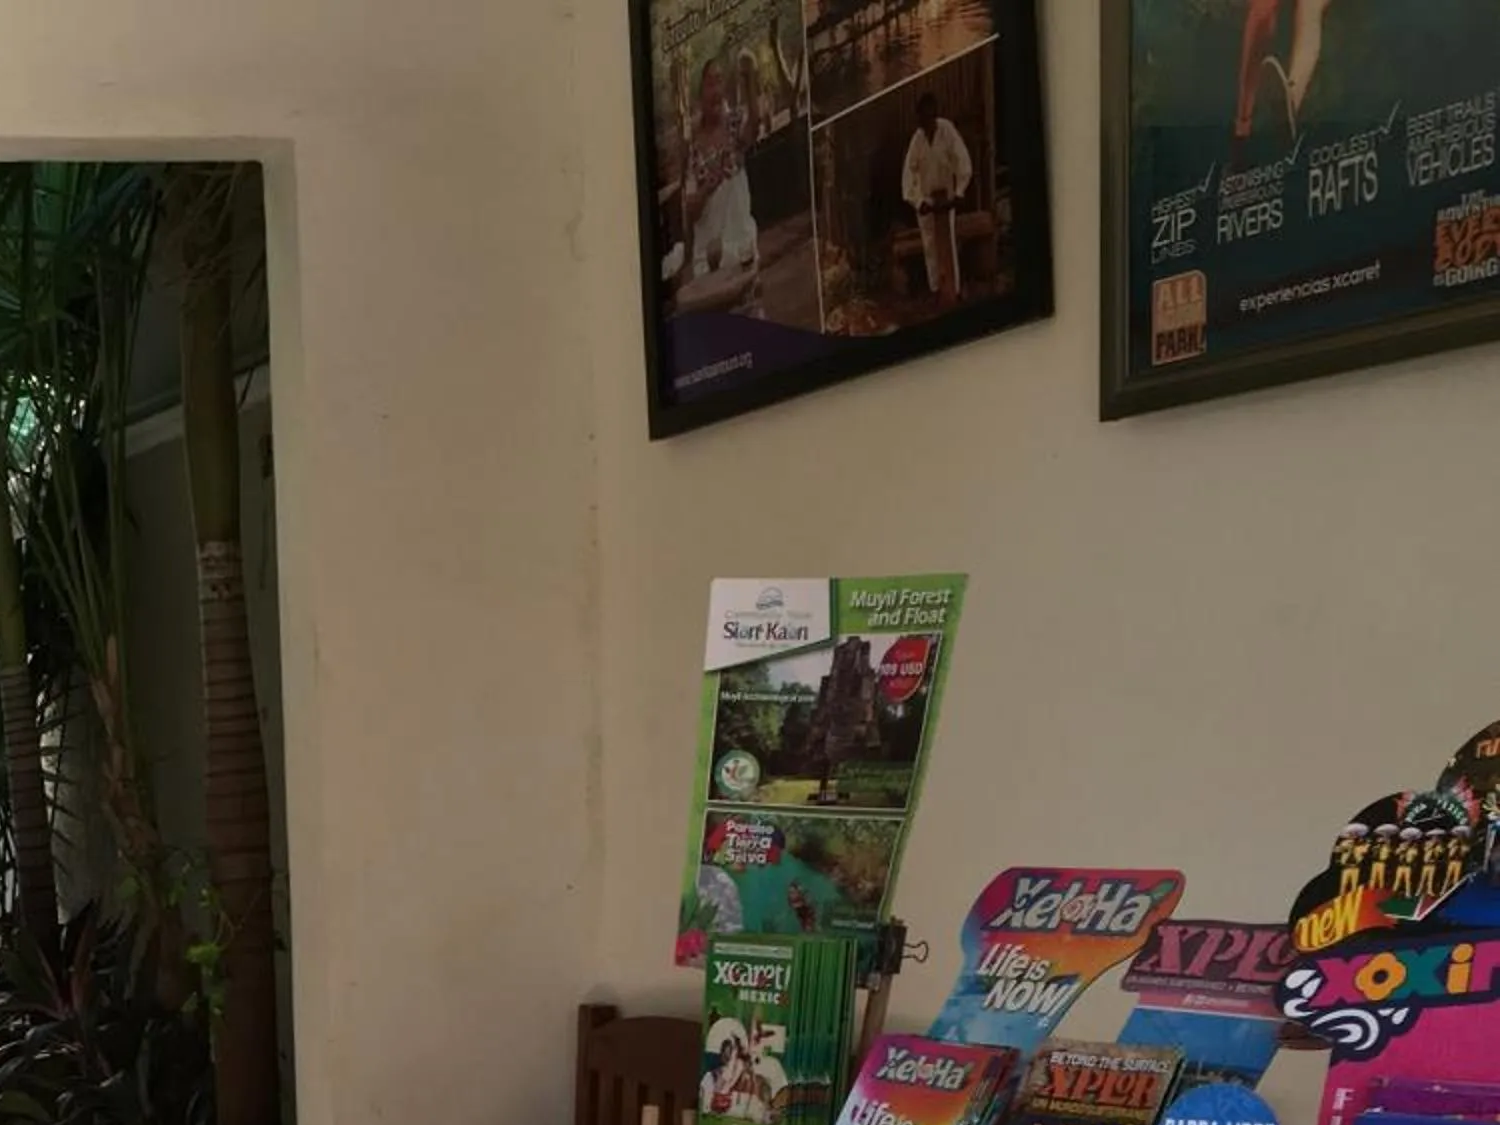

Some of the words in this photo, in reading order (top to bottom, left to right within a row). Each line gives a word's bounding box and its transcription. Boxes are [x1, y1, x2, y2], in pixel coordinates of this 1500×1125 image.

[1309, 132, 1377, 168] COOLEST
[1406, 133, 1496, 188] VEHICLES
[1308, 150, 1379, 218] RAFTS
[1152, 208, 1197, 249] ZIP
[1217, 198, 1284, 245] RIVERS
[849, 589, 897, 612] Muyil
[899, 587, 952, 605] Forest
[867, 611, 901, 627] and
[903, 607, 946, 625] Float
[977, 941, 1033, 980] Life
[1025, 956, 1052, 982] is
[1135, 925, 1297, 982] XPLO
[1099, 1055, 1122, 1071] THE
